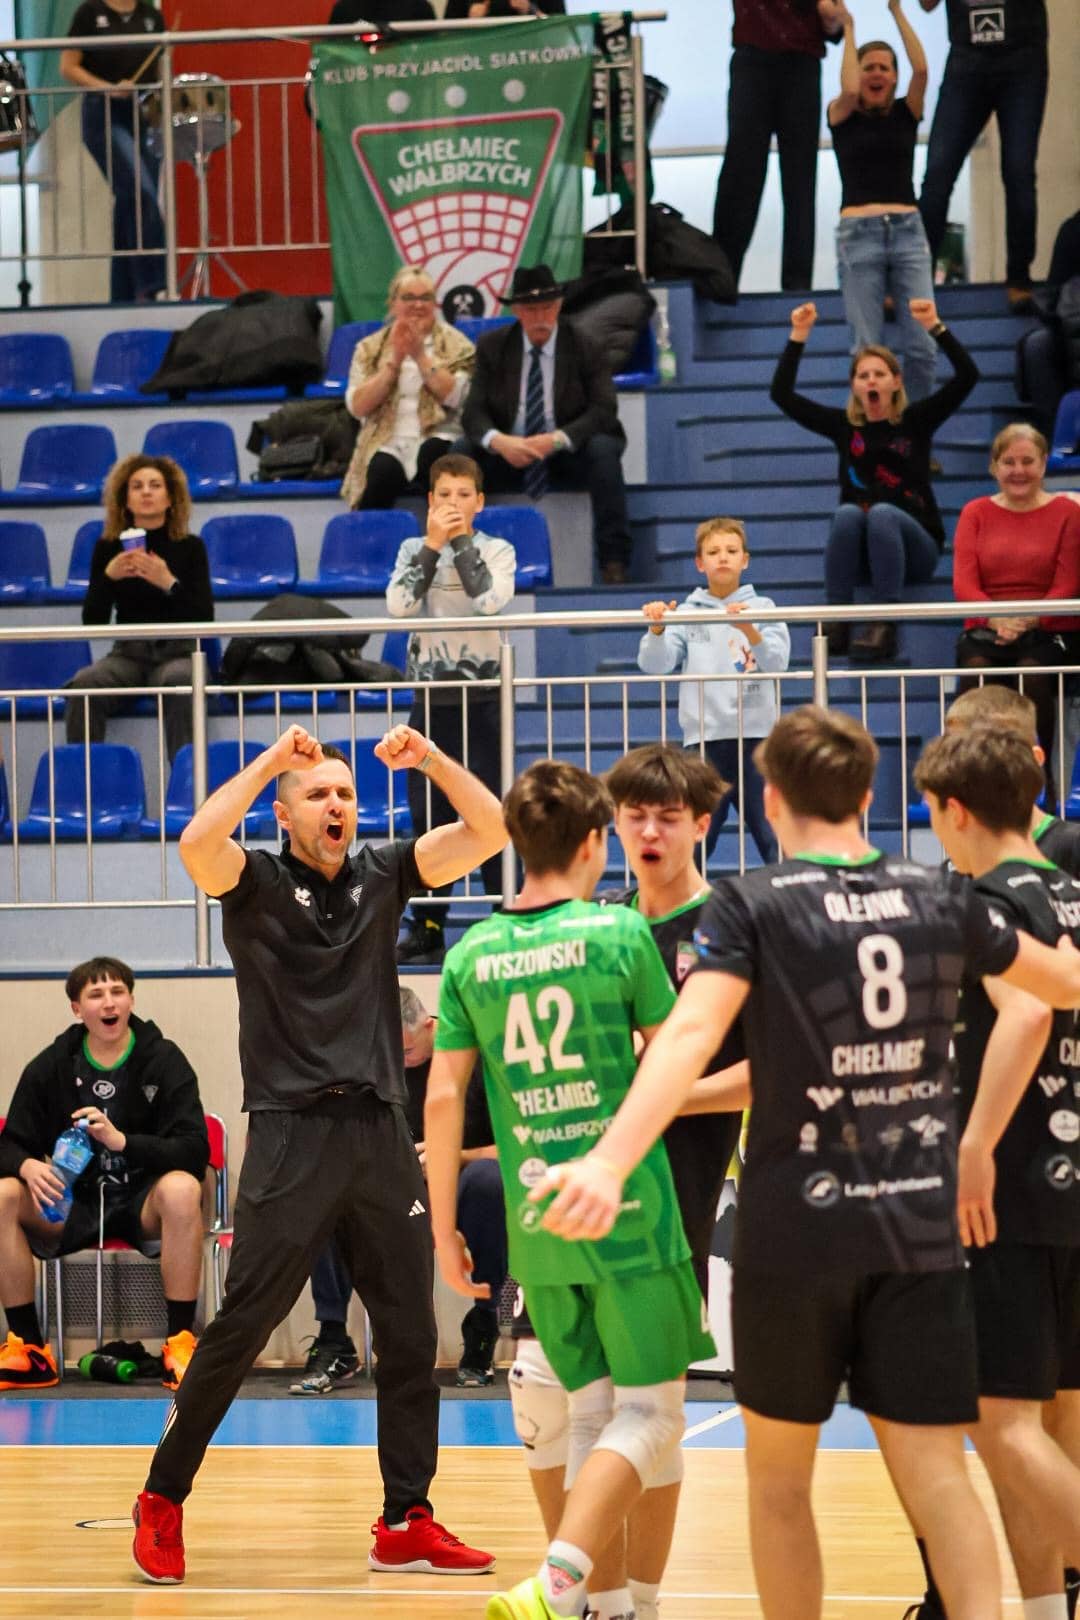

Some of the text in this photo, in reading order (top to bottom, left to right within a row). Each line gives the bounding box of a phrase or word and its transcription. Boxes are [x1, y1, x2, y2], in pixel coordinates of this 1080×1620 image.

[323, 65, 369, 85] KLUB
[397, 136, 520, 169] CHEŁMIEC
[388, 161, 532, 197] WAŁBRZYCH
[475, 938, 586, 983] WYSZOWSKI
[857, 934, 907, 1030] 8
[503, 985, 584, 1075] 42
[512, 1079, 600, 1118] HEŁMIEC
